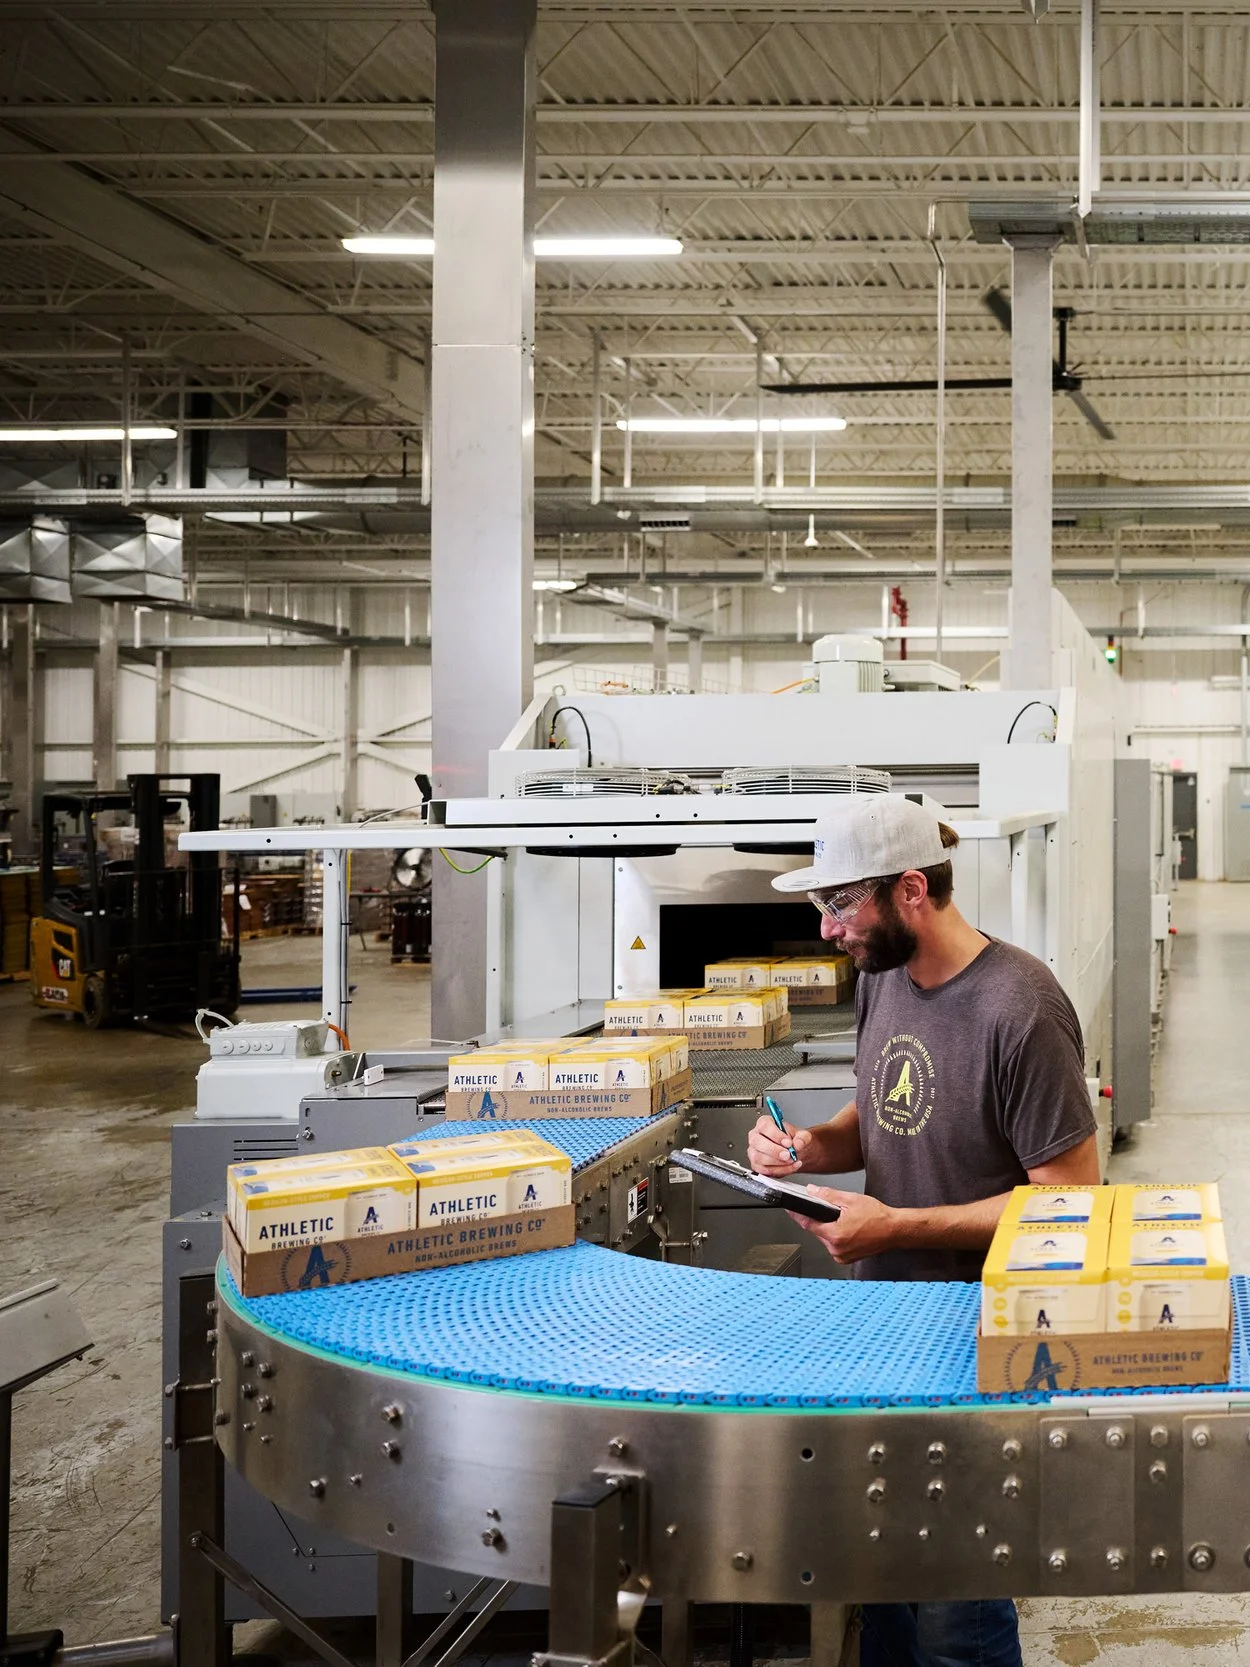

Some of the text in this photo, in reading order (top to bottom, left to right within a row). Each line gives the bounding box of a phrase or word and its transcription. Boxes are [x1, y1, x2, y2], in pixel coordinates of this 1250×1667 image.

[59, 959, 70, 977] CAT
[914, 1038, 935, 1079] COMPROMISE
[454, 1075, 498, 1085] ATHLETIC
[555, 1074, 599, 1083] ATHLETIC
[530, 1095, 571, 1104] ATHLETIC
[574, 1094, 616, 1103] BREWING
[924, 1105, 933, 1118] USA
[895, 1127, 905, 1136] CO.
[430, 1194, 497, 1216] ATHLETIC
[518, 1201, 542, 1210] ATHLETIC
[440, 1214, 476, 1226] BREWING
[259, 1217, 334, 1240] ATHLETIC
[357, 1224, 384, 1233] ATHLETIC
[272, 1238, 311, 1249] BREWING
[388, 1234, 454, 1254] ATHLETIC
[459, 1223, 523, 1243] BREWING
[415, 1240, 517, 1263] NON-ALCOHOLIC BREWS
[1093, 1354, 1139, 1365] ATHLETIC
[1142, 1352, 1187, 1363] BREWING
